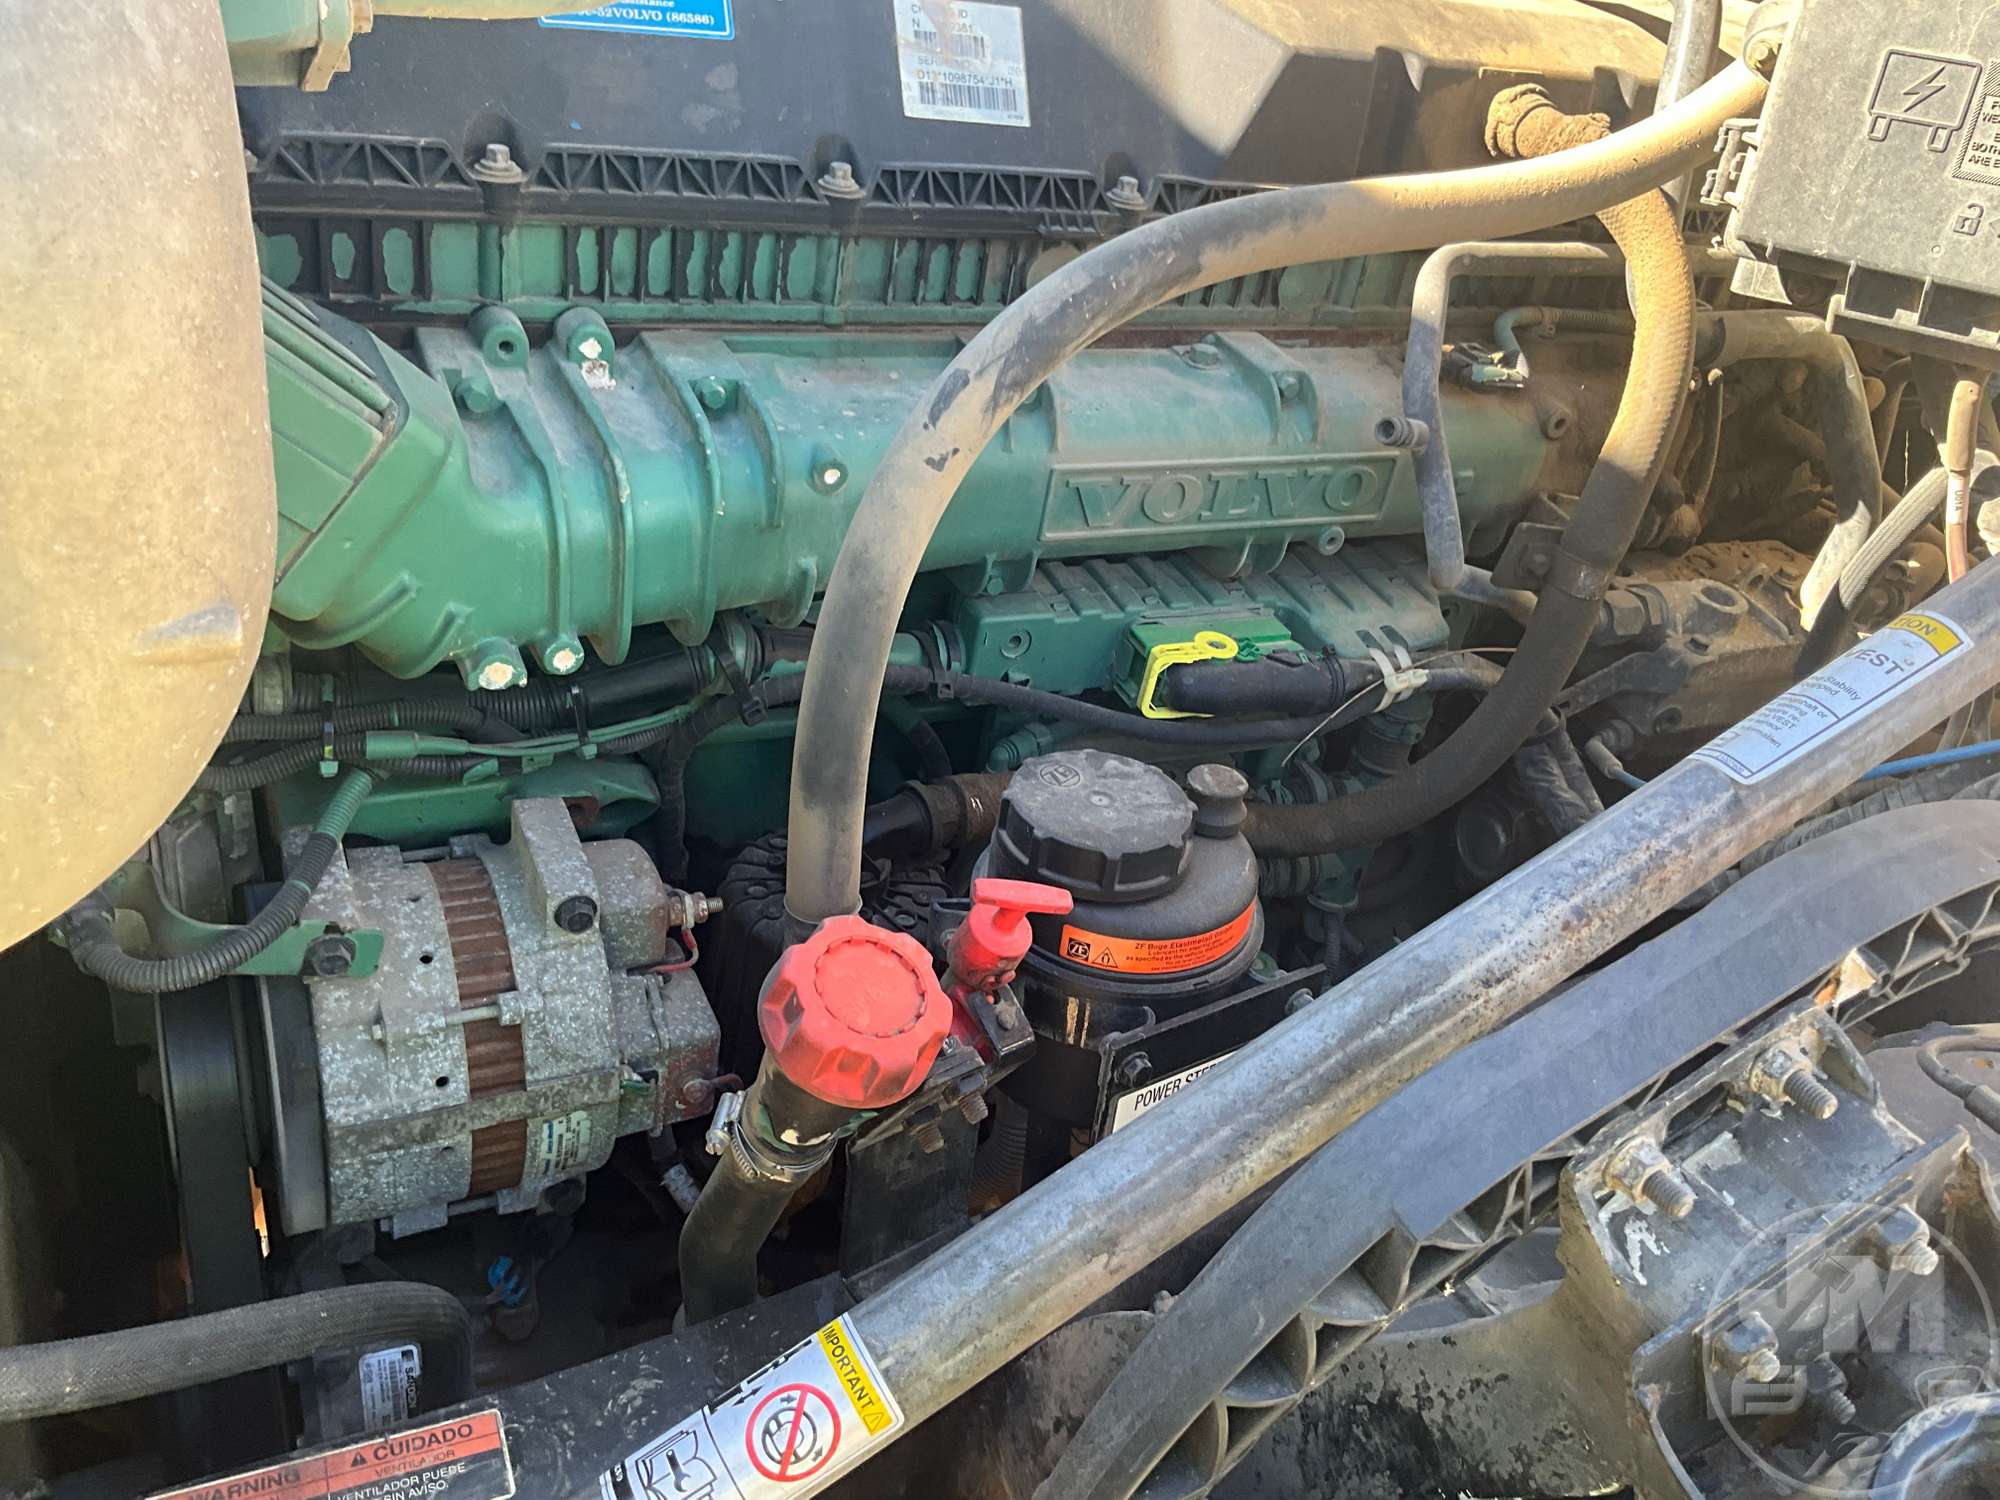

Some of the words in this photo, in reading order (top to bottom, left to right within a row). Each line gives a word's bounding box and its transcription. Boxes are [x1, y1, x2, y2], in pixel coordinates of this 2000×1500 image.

[1065, 464, 1378, 528] VOLVO
[1069, 941, 1089, 959] ZF
[1134, 1078, 1181, 1111] POWER
[822, 1325, 875, 1410] IMPORTANT
[373, 1423, 473, 1461] CUIDADO
[422, 1462, 466, 1482] PUEDE
